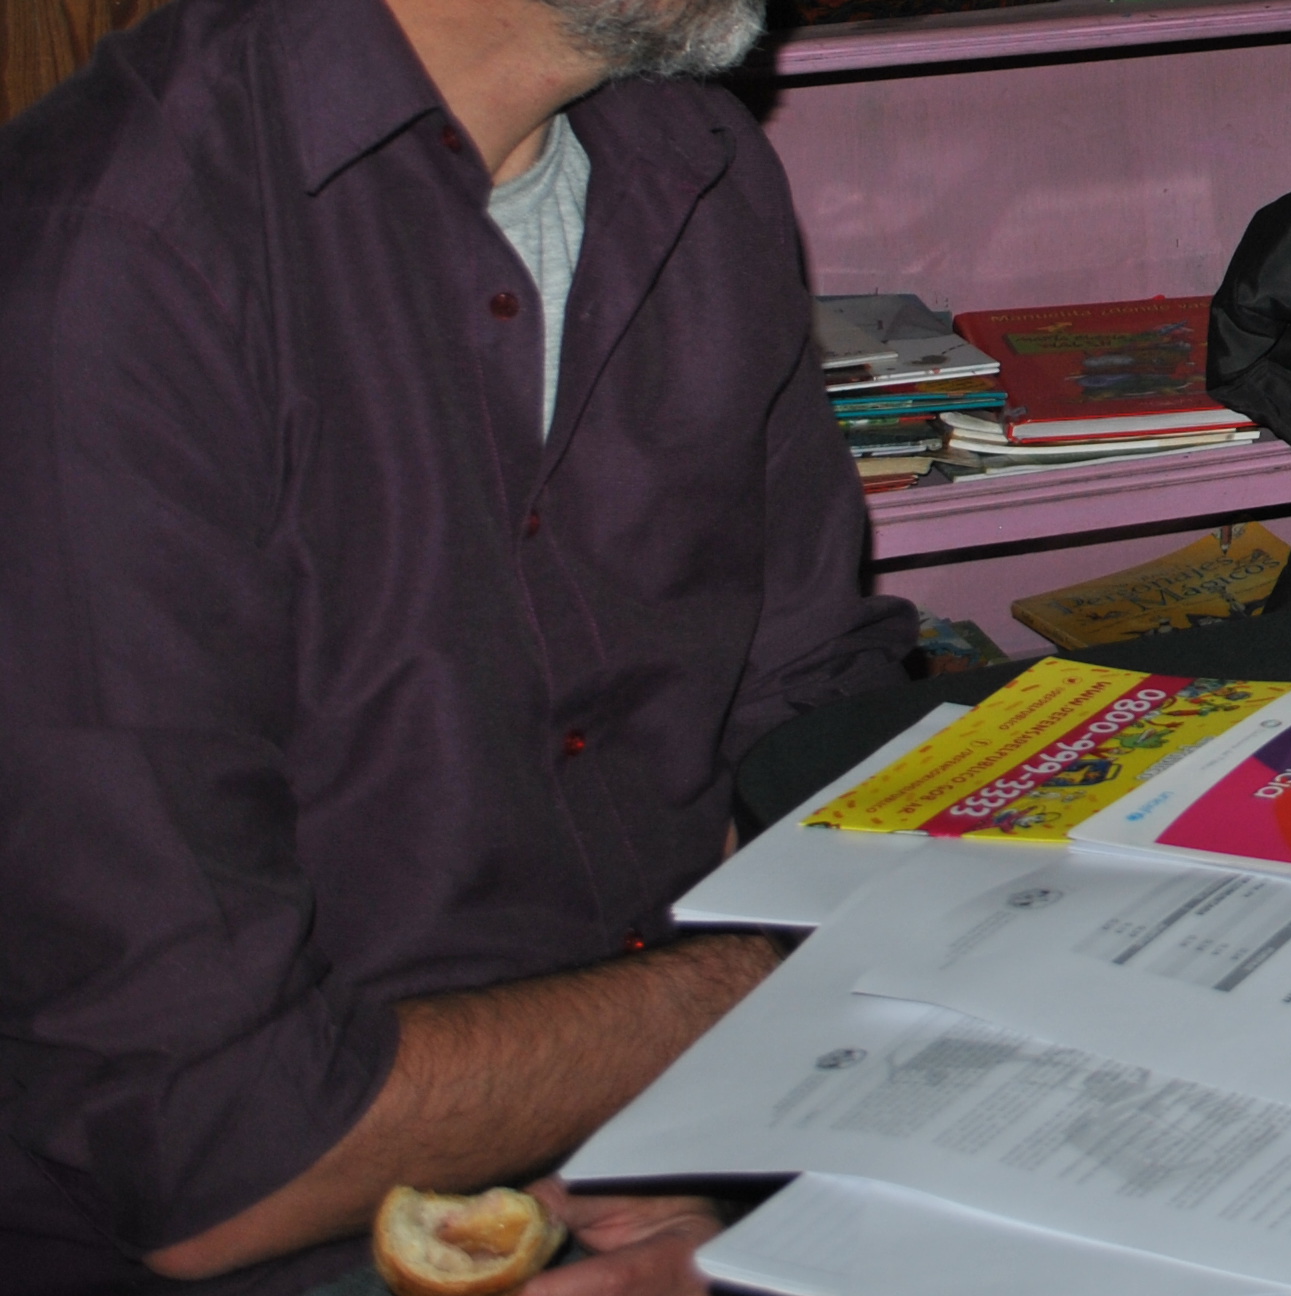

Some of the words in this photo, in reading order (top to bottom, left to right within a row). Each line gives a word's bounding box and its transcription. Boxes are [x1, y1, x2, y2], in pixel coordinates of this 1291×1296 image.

[990, 308, 1092, 324] Manuelita
[1048, 555, 1234, 616] Personajes
[1125, 556, 1281, 612] Mágicos
[949, 689, 1167, 817] 0800-999-3333
